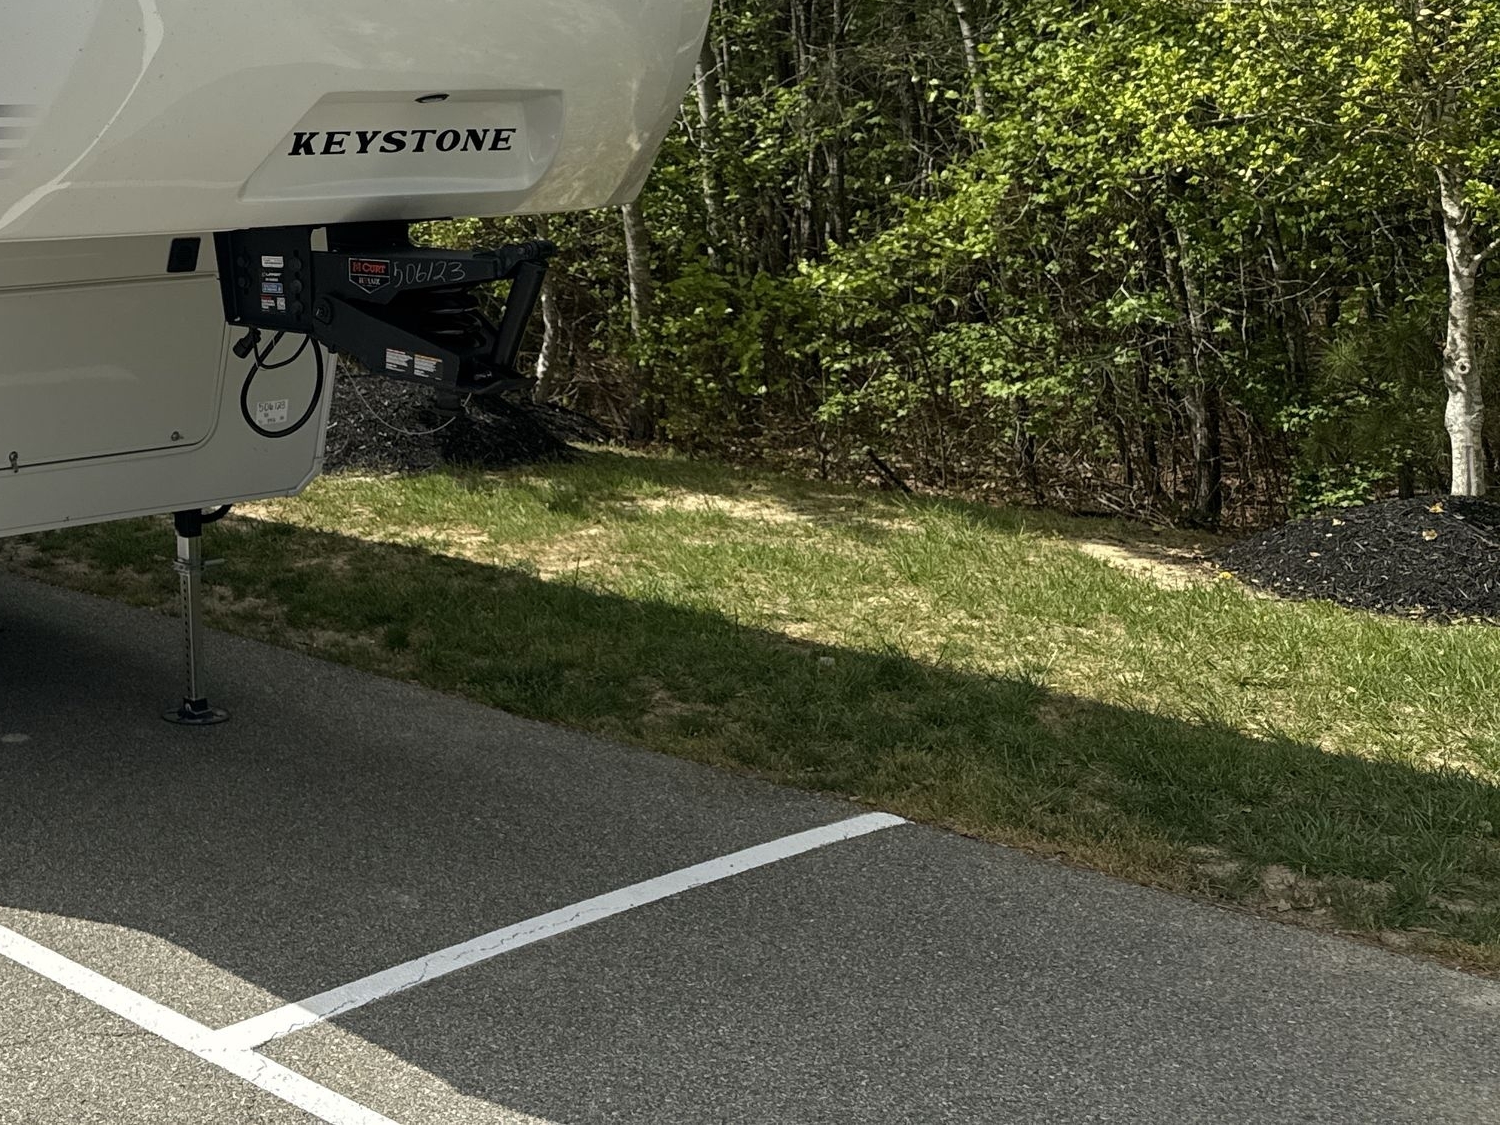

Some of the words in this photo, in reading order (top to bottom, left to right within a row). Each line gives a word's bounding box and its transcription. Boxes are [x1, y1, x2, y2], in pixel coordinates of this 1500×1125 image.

[288, 128, 516, 156] KEYSTONE
[362, 262, 386, 274] CURT
[393, 261, 465, 288] 506123
